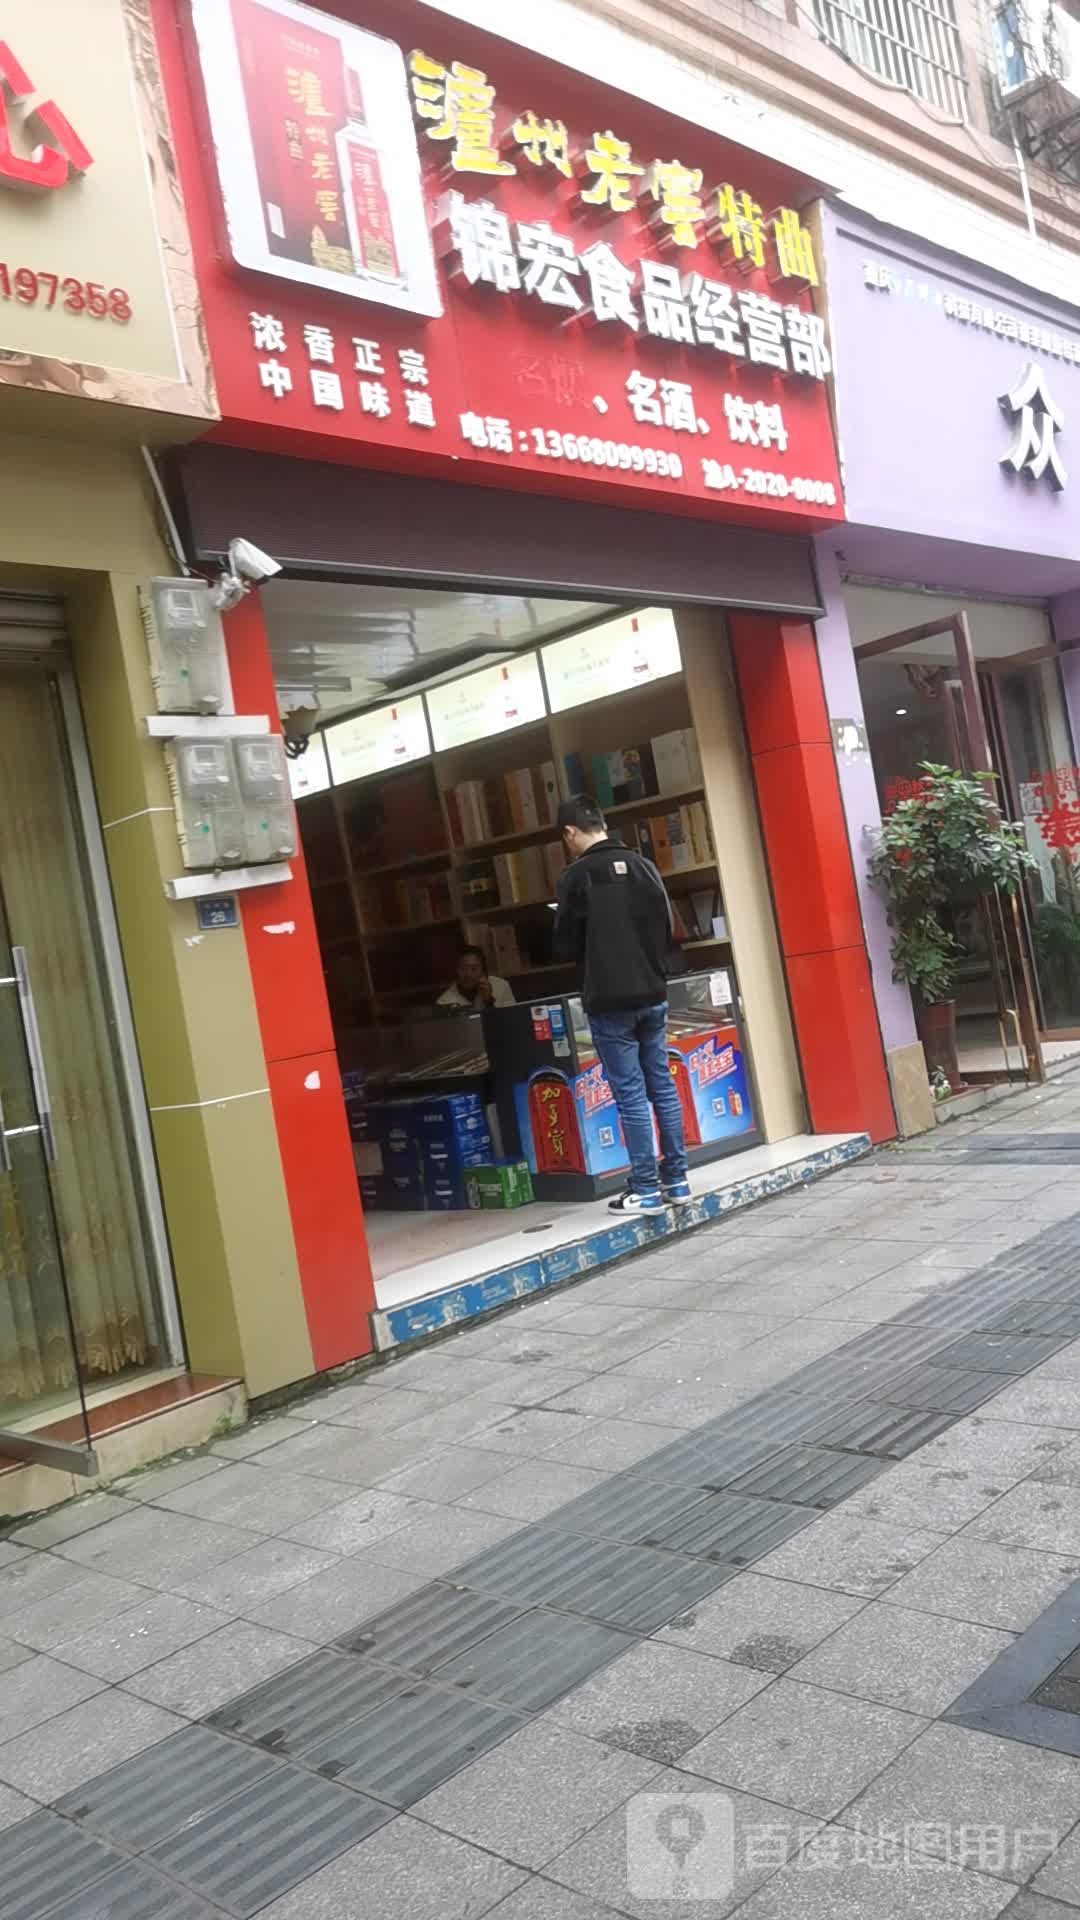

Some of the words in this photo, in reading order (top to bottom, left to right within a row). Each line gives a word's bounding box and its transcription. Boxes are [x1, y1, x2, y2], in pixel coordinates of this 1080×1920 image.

[443, 190, 832, 382] 锦宏食品经营部
[249, 311, 430, 386] 浓香正宗
[259, 359, 436, 428] 中国味道
[997, 359, 1068, 492] 众
